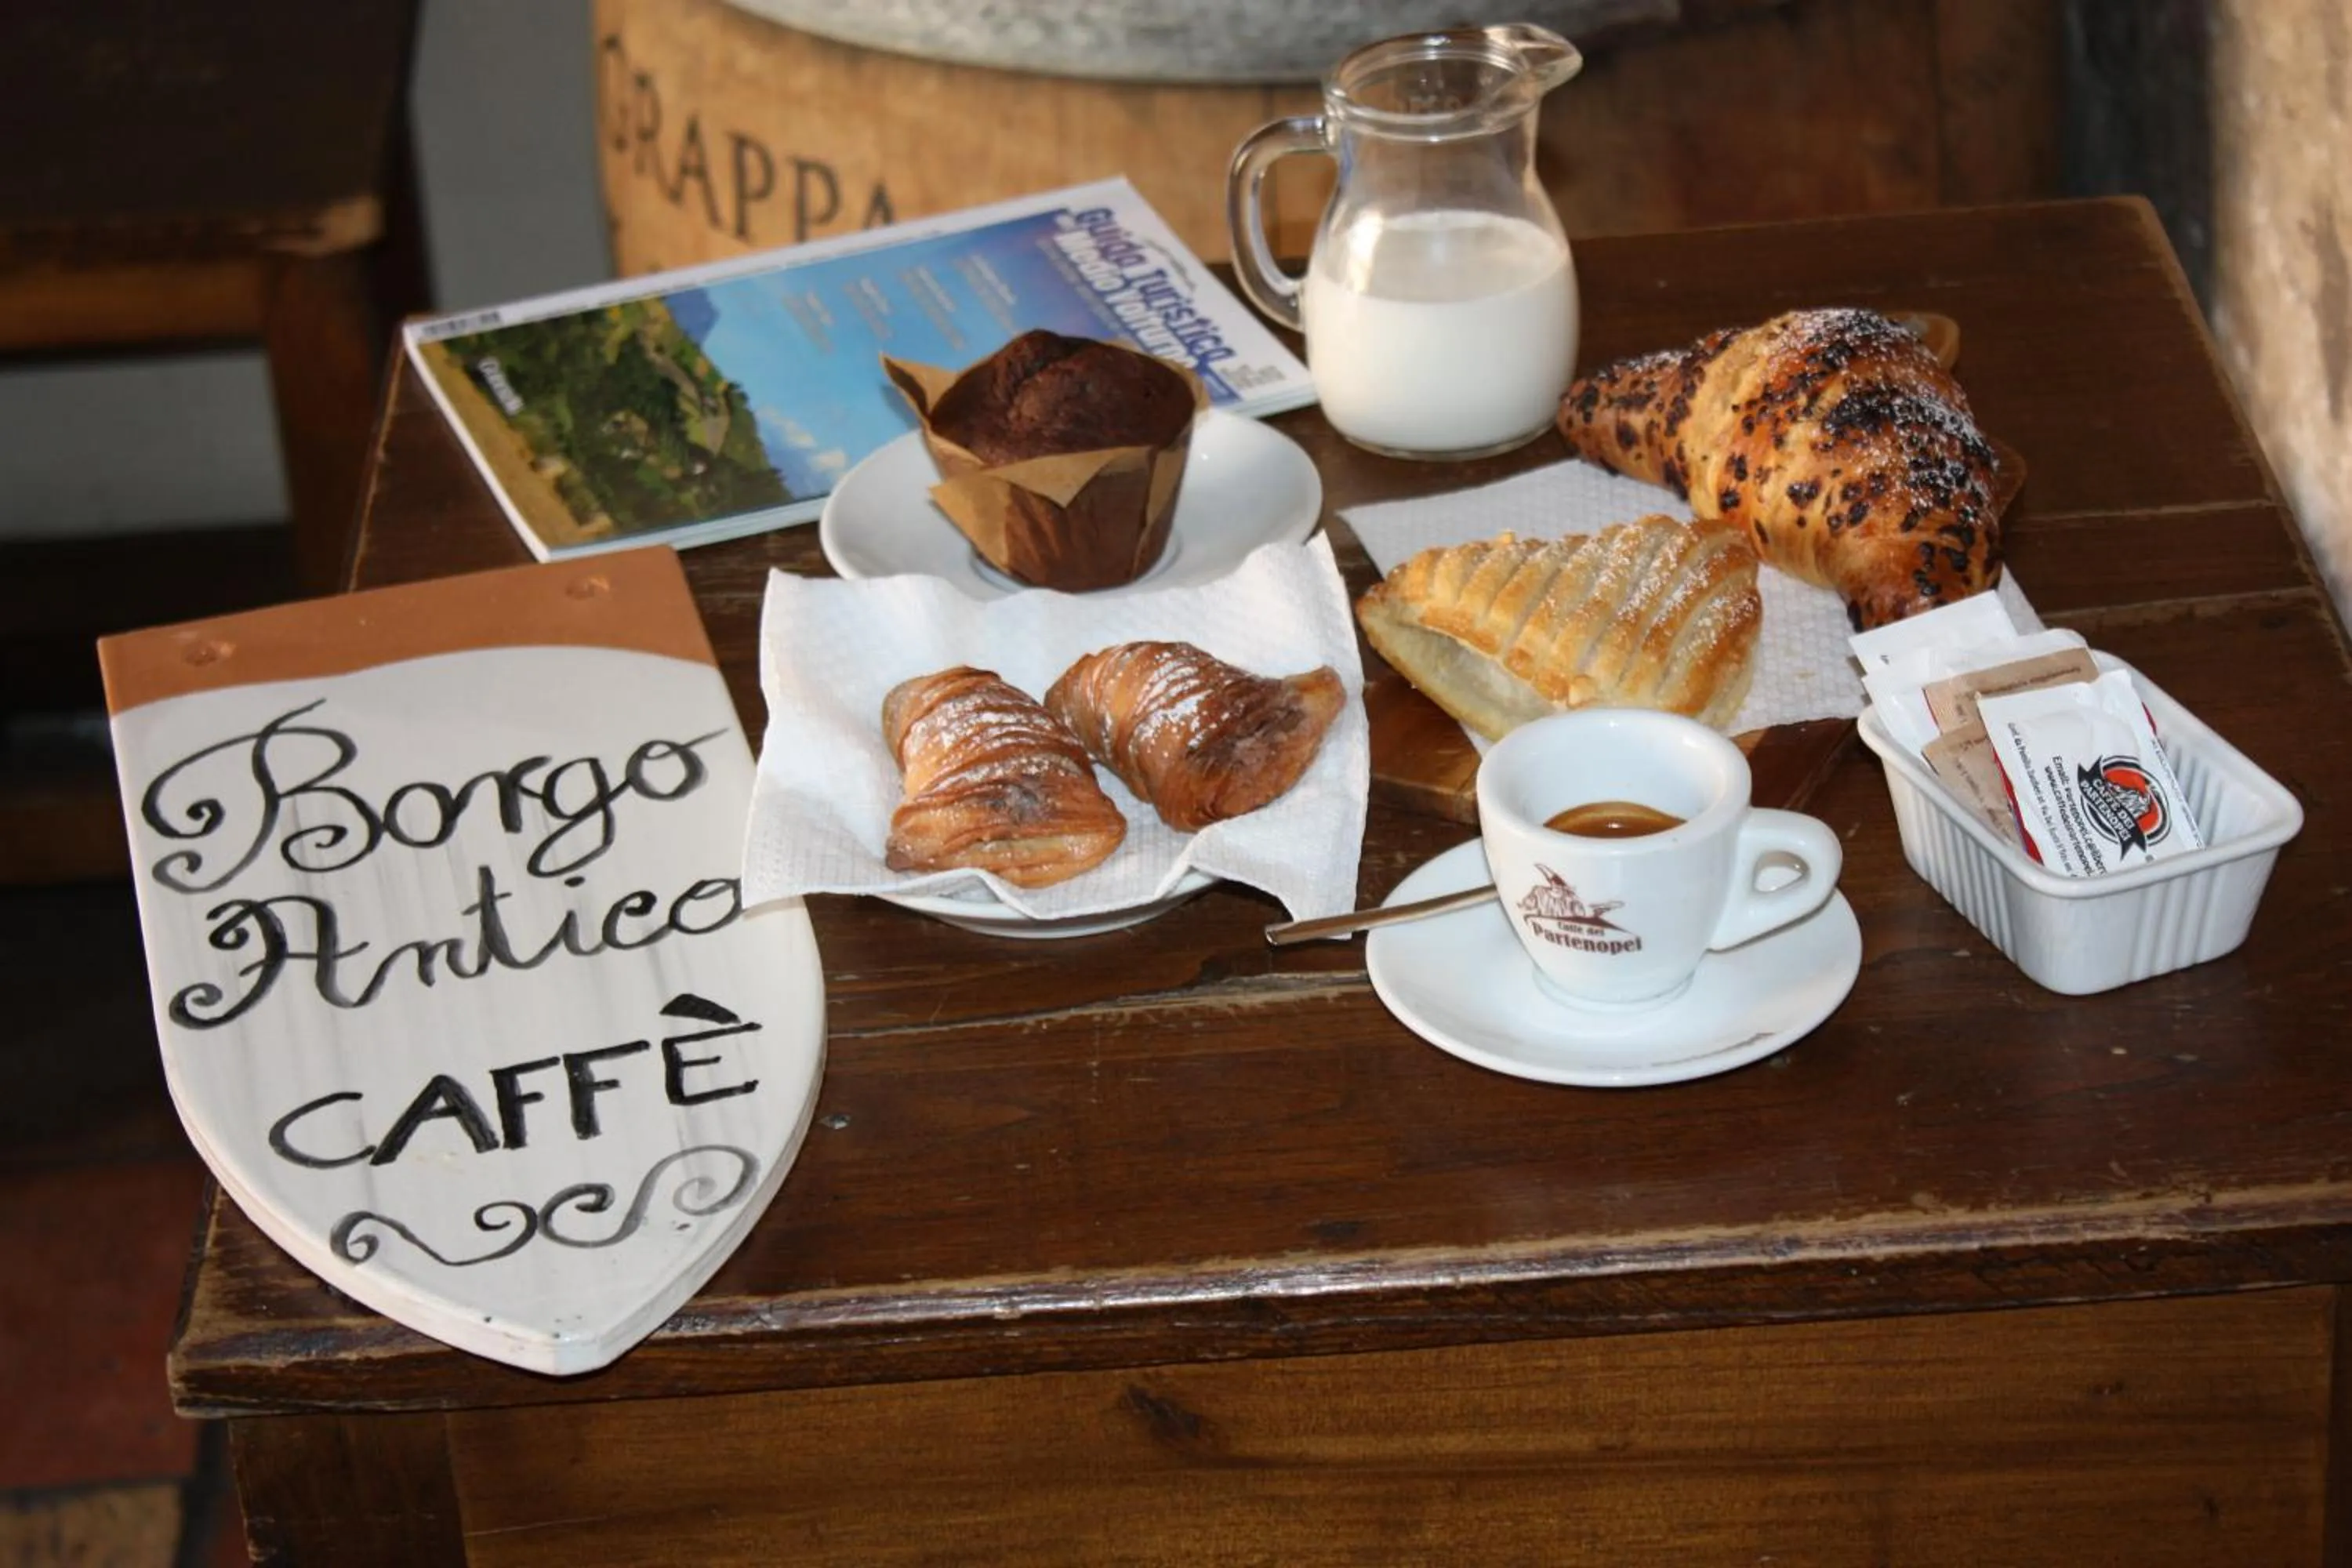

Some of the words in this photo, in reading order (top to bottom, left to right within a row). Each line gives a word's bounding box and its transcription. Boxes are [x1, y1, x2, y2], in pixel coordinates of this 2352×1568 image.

[1073, 207, 1147, 267] Guida
[141, 699, 731, 895] Borgo
[2080, 780, 2132, 841] PARTENOPEI
[2117, 810, 2134, 830] DEI
[169, 866, 742, 1030] Antico
[1532, 920, 1643, 956] Partenopei
[268, 993, 762, 1169] CAFFÈ
